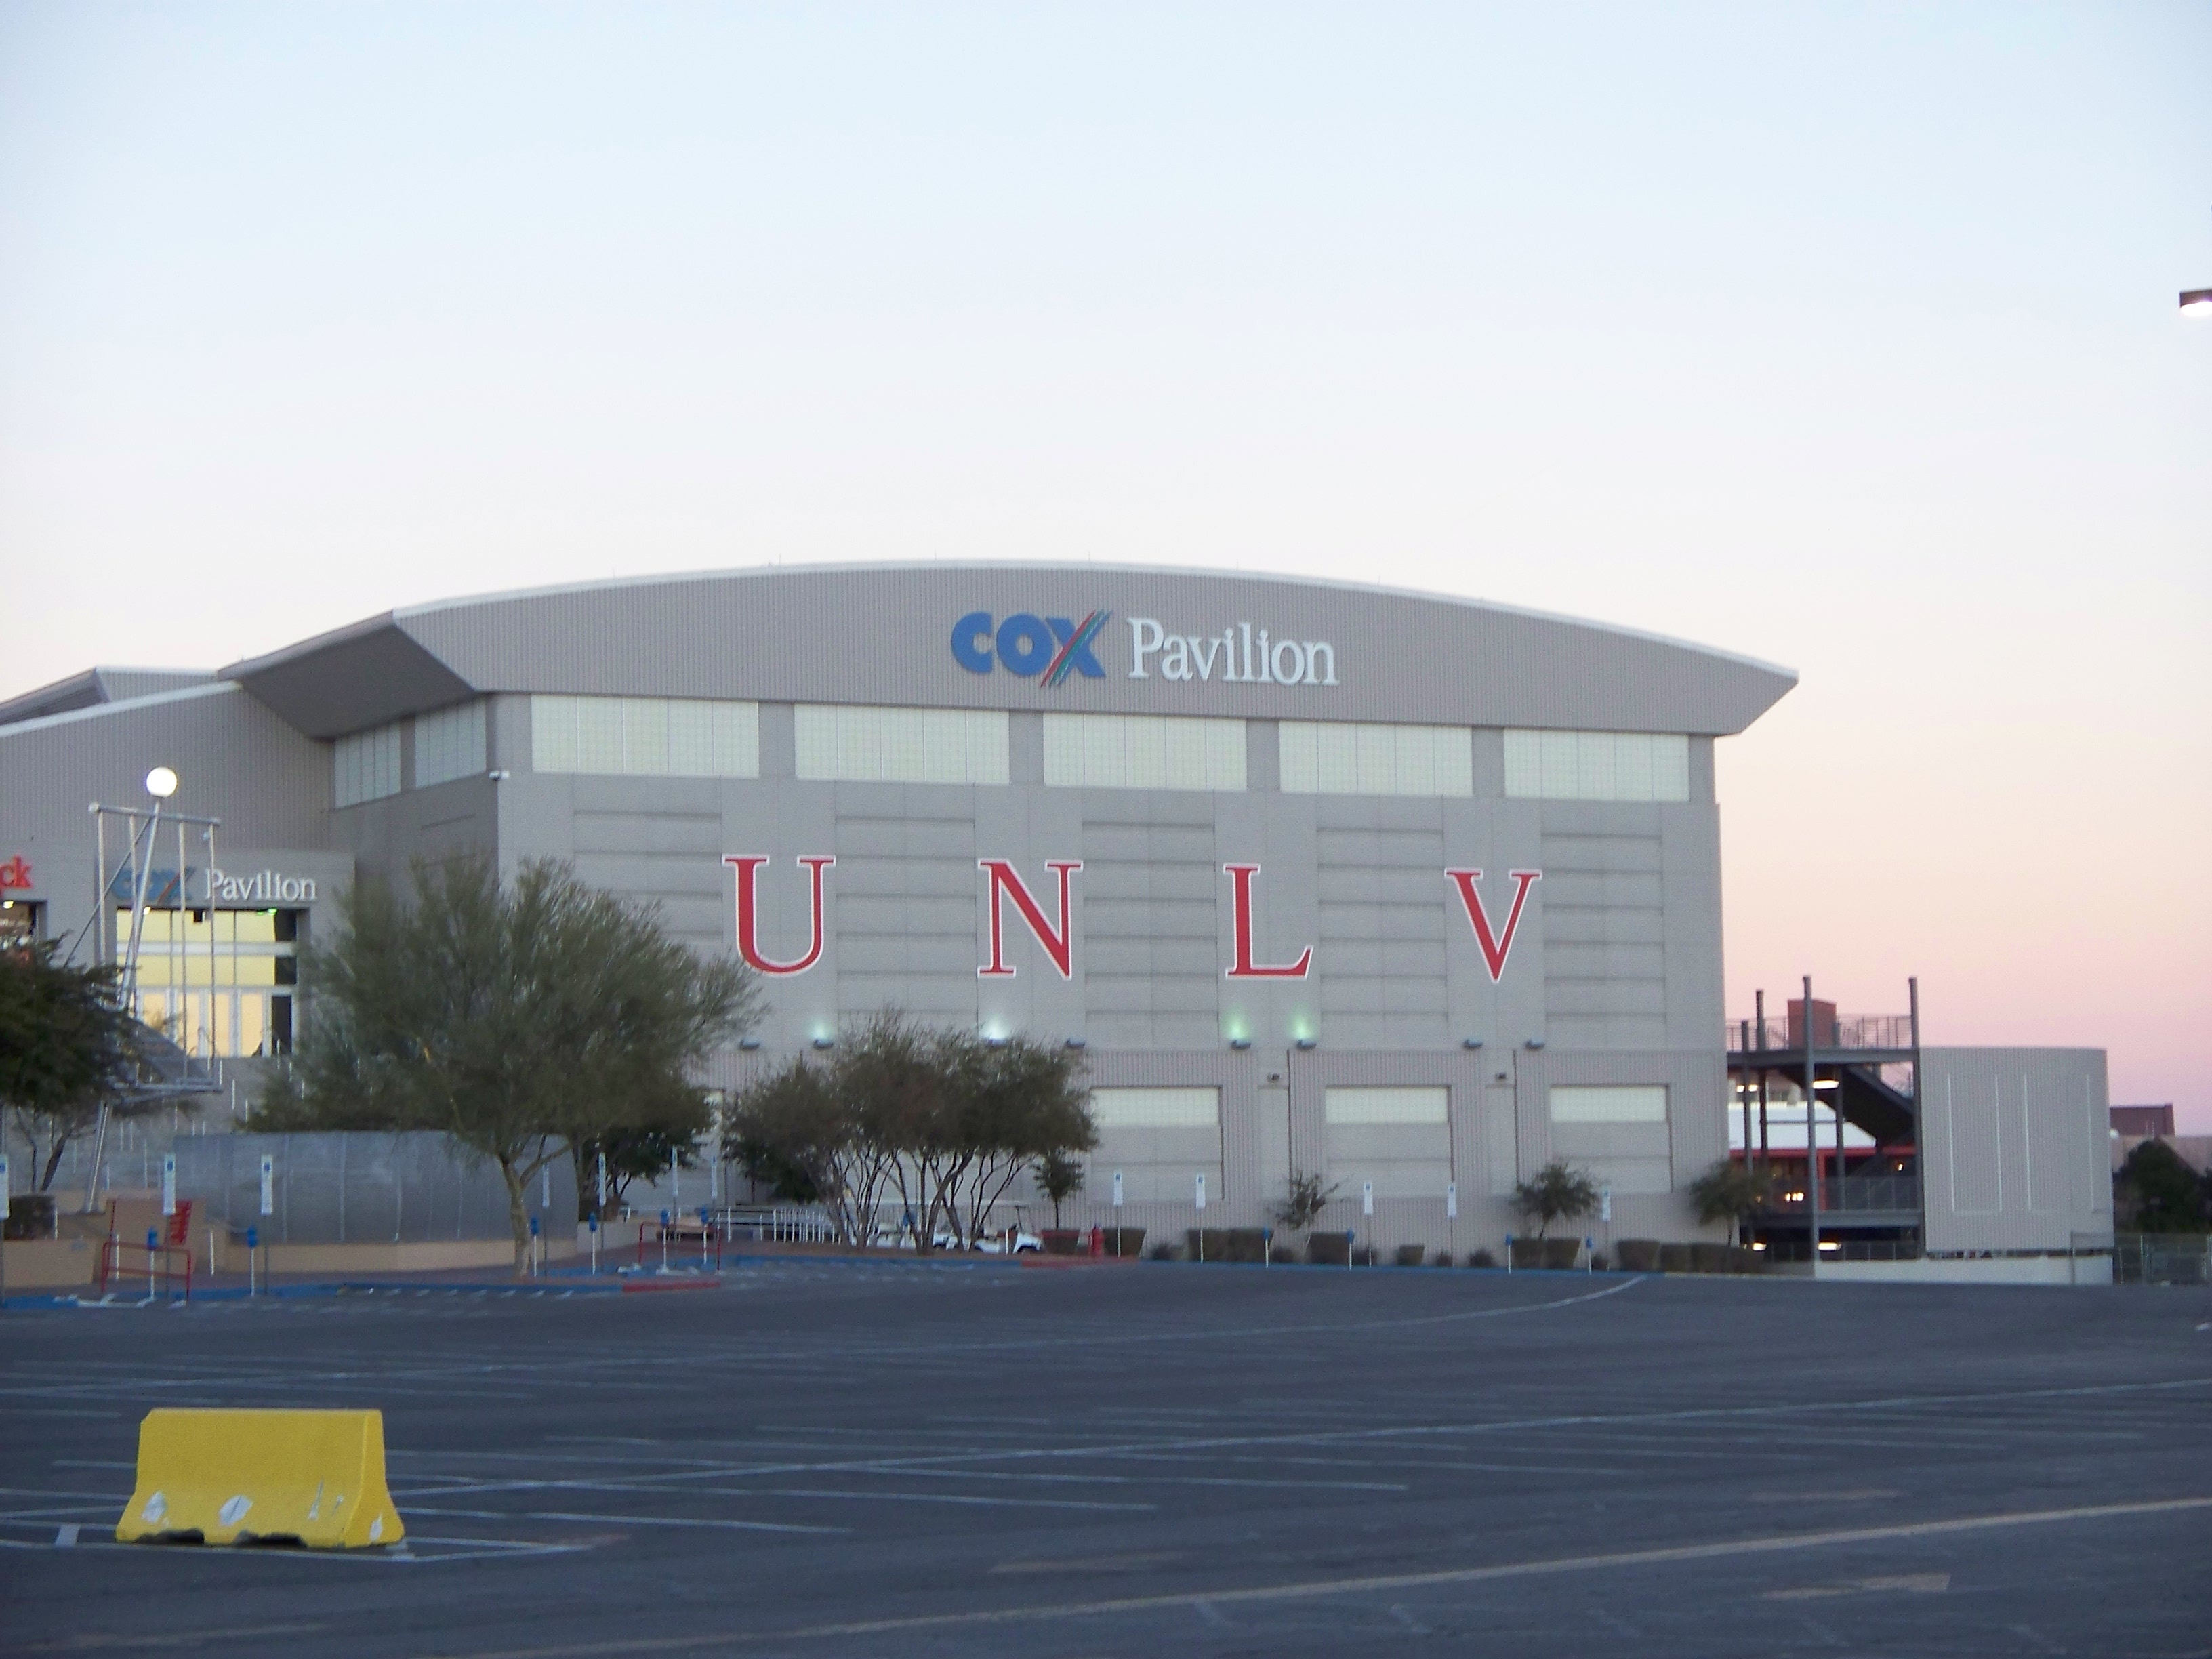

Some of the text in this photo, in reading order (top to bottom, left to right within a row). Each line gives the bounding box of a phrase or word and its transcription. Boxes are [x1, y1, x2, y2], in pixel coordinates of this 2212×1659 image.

[951, 609, 1340, 688] COX Pavilion
[205, 868, 316, 902] Pavilion
